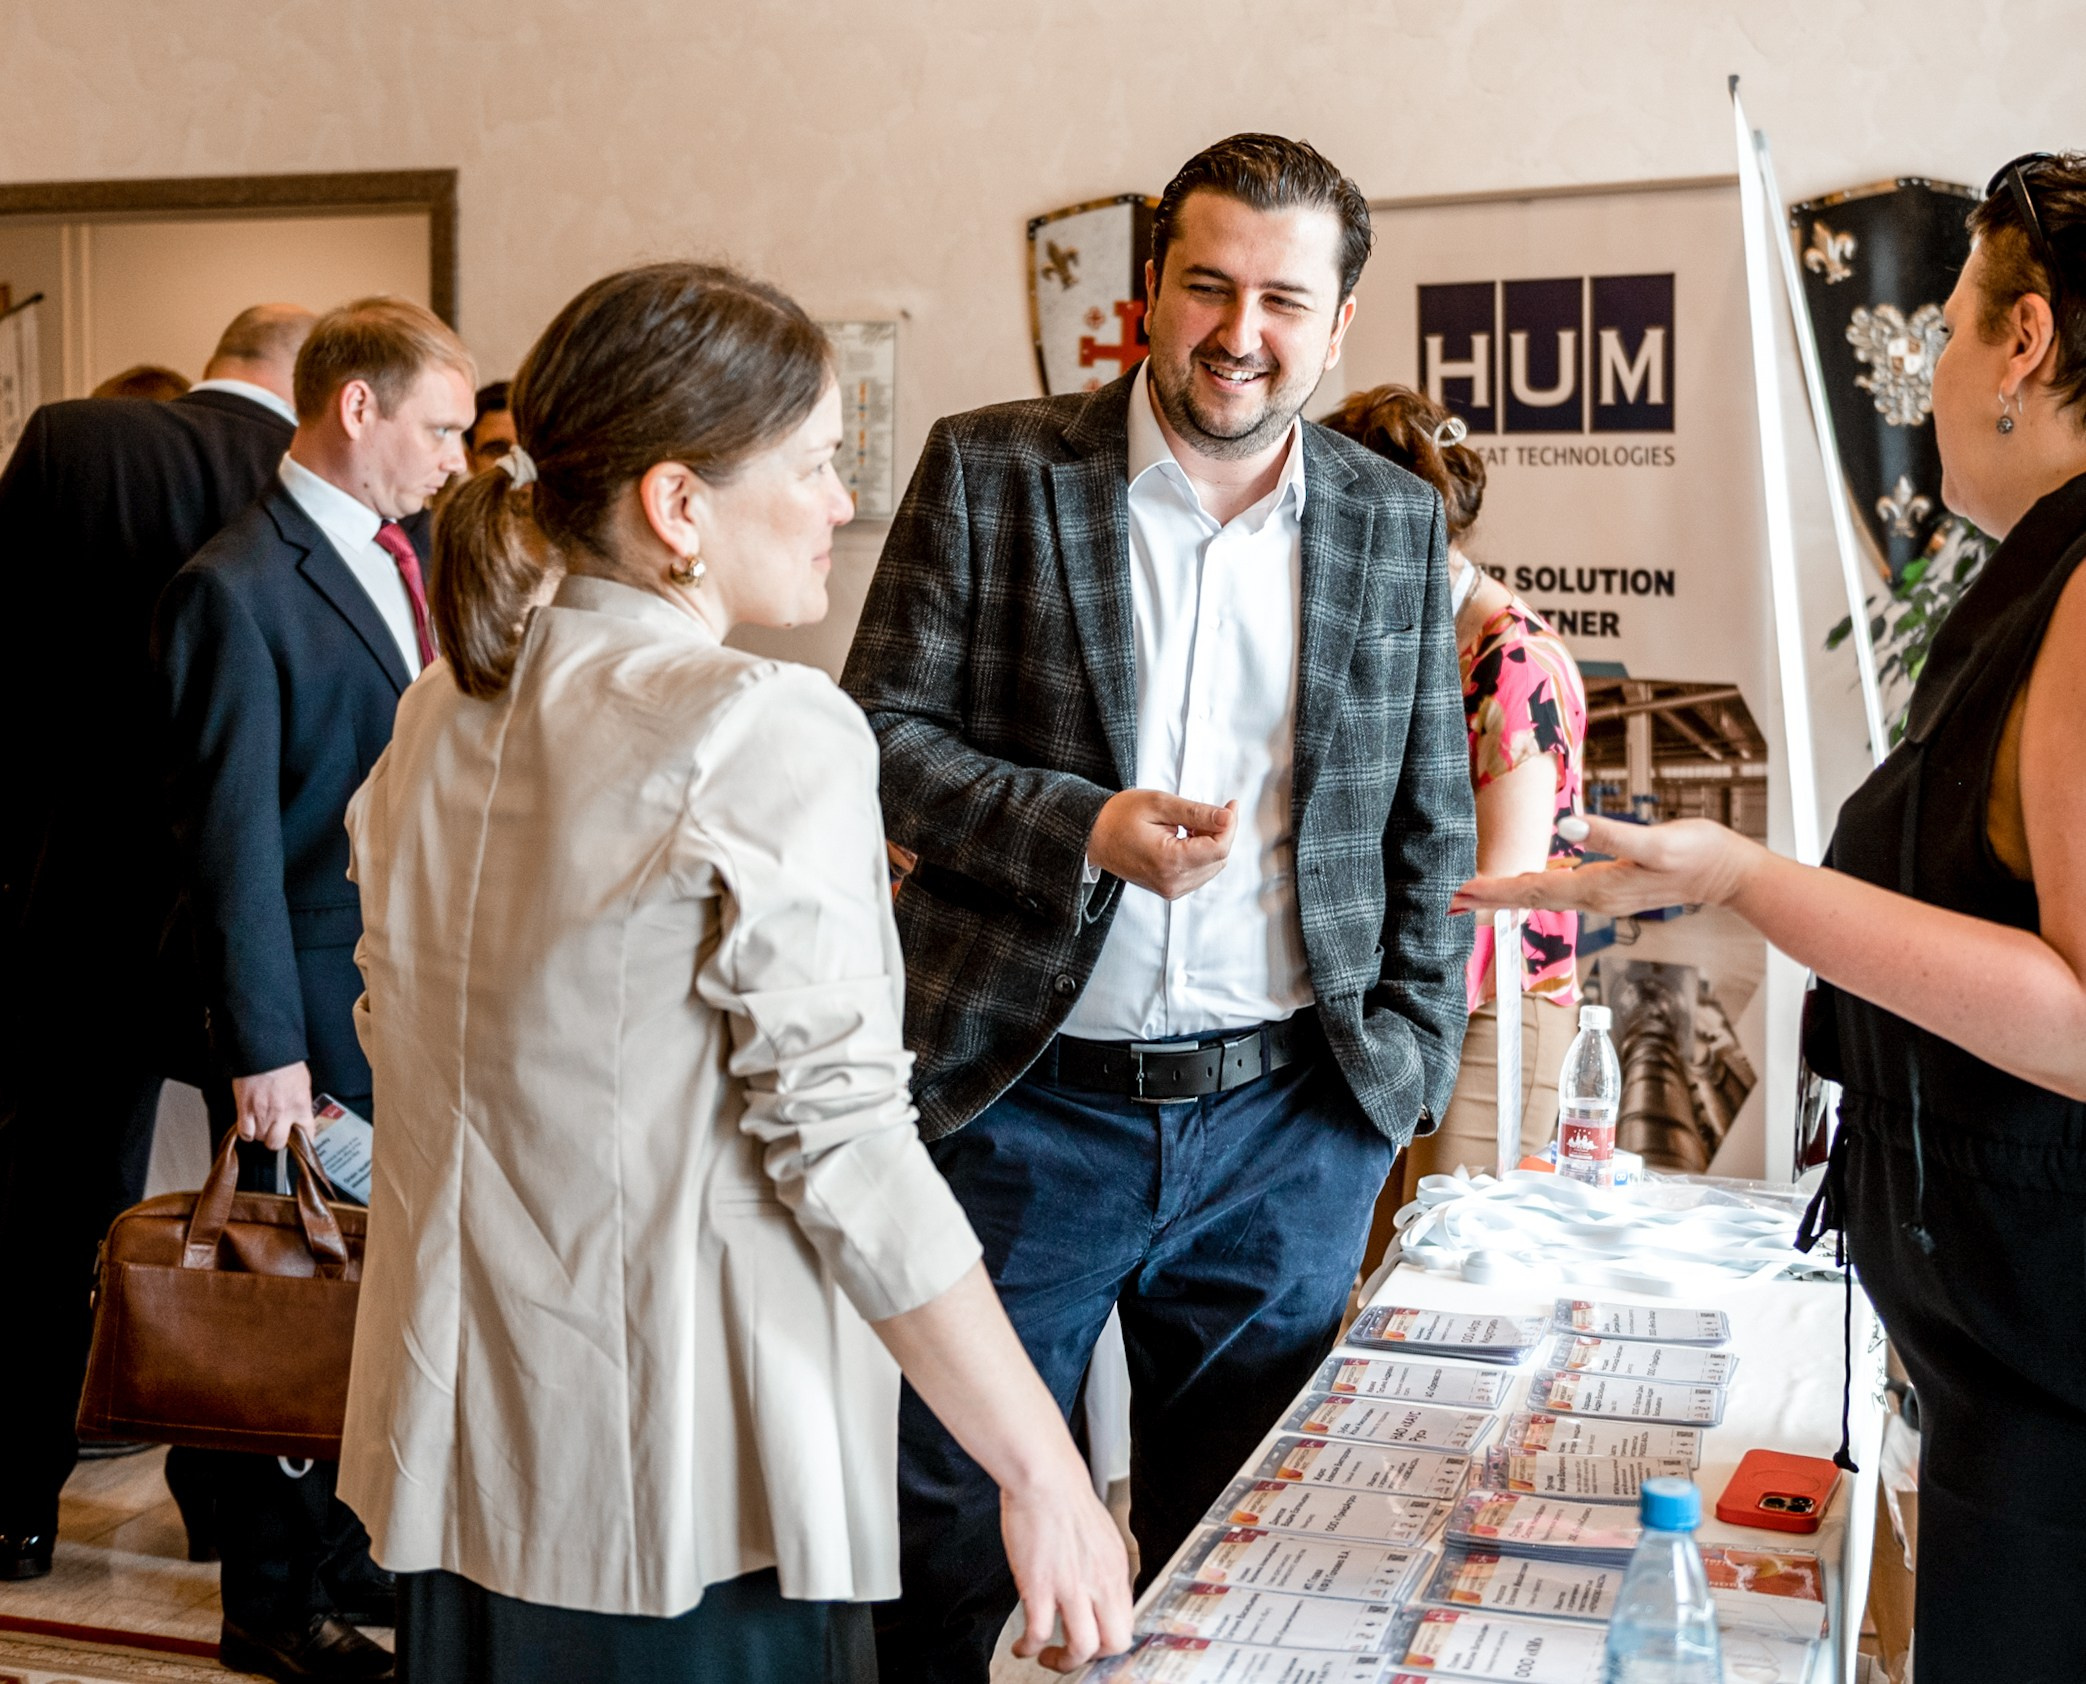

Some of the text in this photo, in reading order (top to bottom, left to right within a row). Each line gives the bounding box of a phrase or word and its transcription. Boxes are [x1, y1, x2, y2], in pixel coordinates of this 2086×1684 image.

[1426, 326, 1664, 408] HUM
[1517, 446, 1675, 466] TECHNOLOGIES
[1514, 566, 1675, 597] SOLUTION
[1537, 609, 1621, 638] TNER
